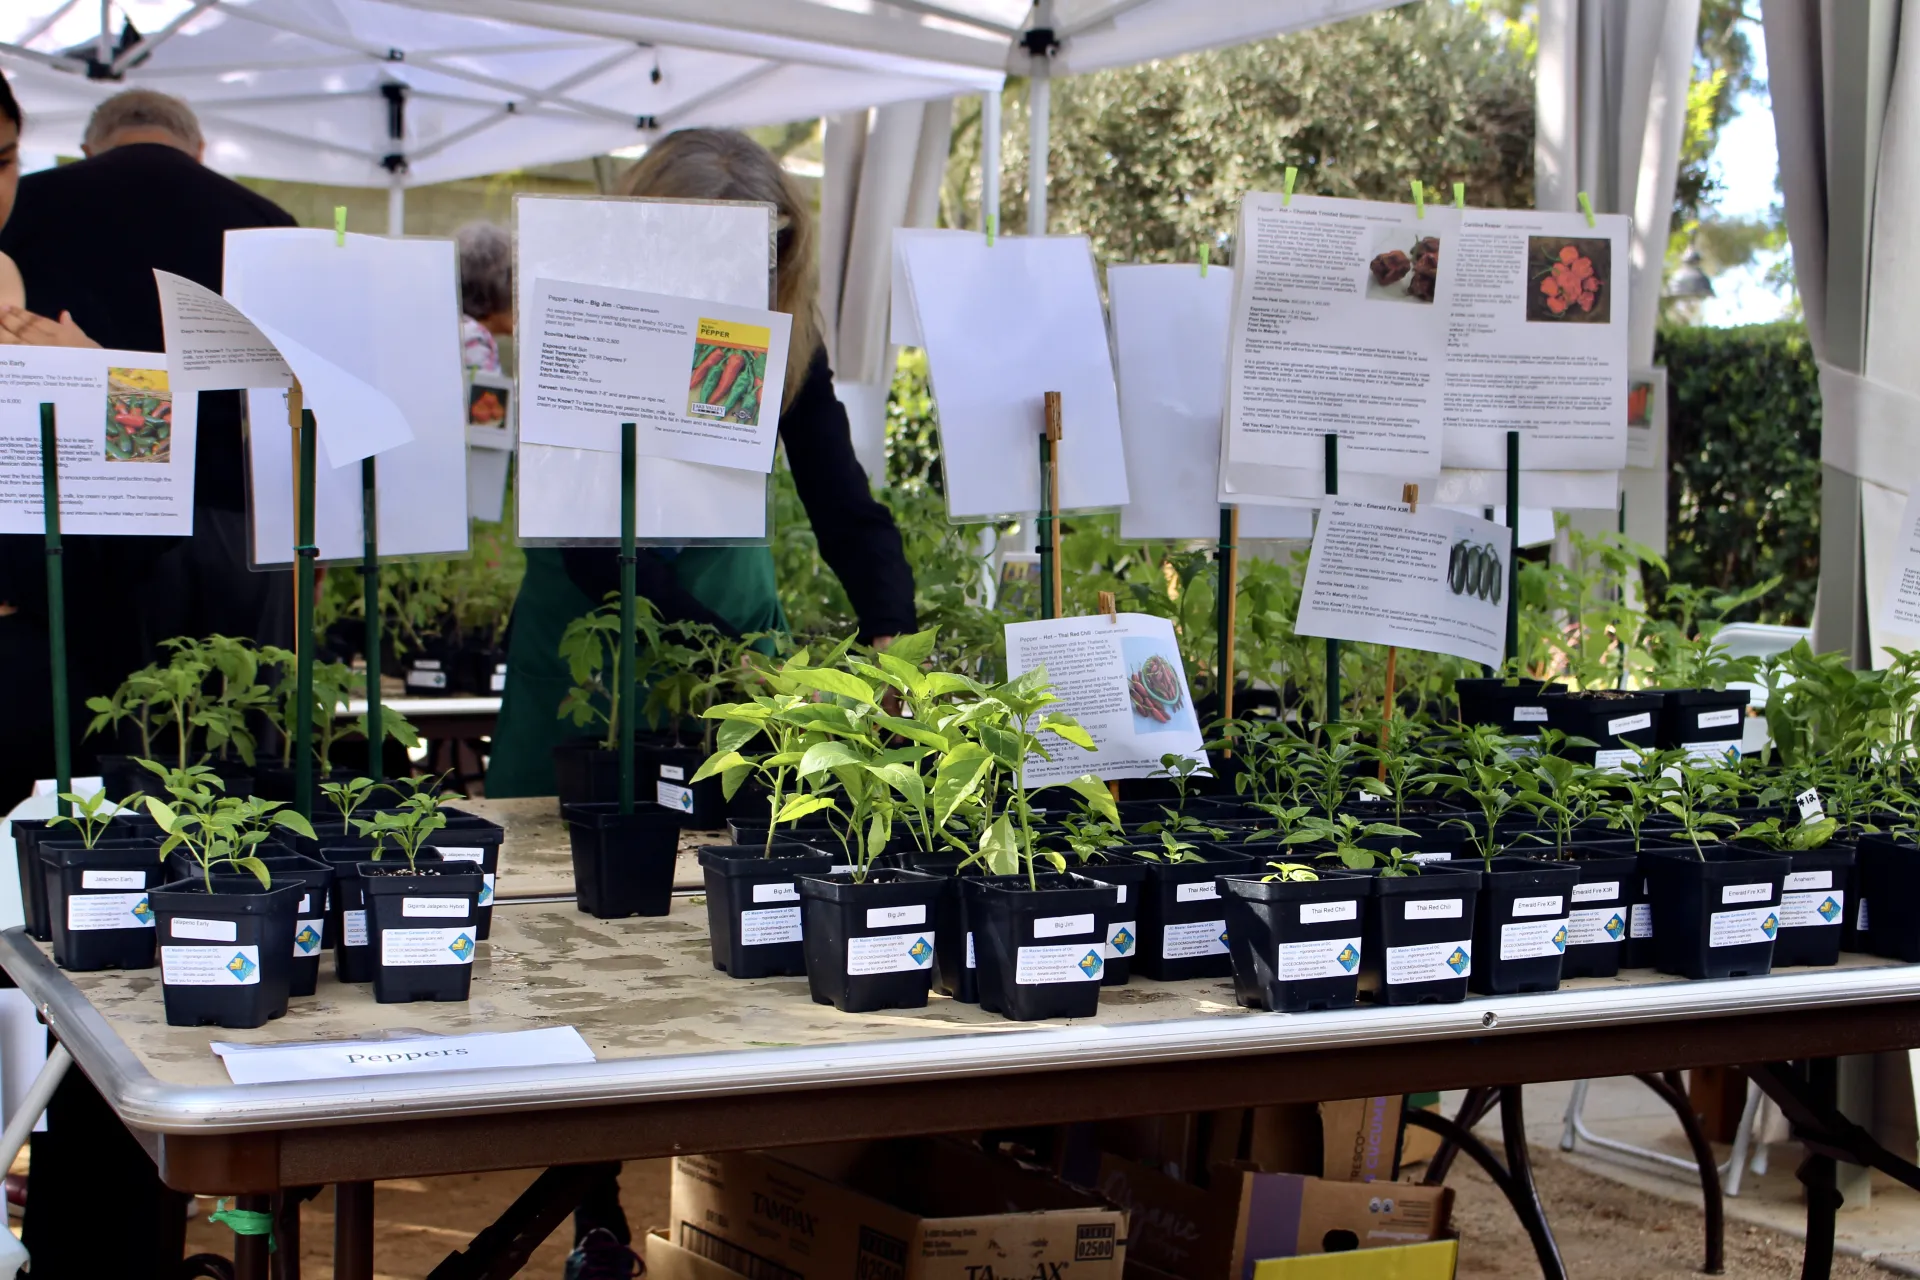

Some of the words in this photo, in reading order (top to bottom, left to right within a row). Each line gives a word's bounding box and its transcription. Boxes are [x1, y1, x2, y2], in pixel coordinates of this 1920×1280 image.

[590, 299, 600, 308] Big
[700, 328, 730, 338] PEPPER
[346, 1048, 469, 1064] Peppers
[752, 1192, 816, 1238] TAMPAX
[1078, 1241, 1111, 1257] 02500
